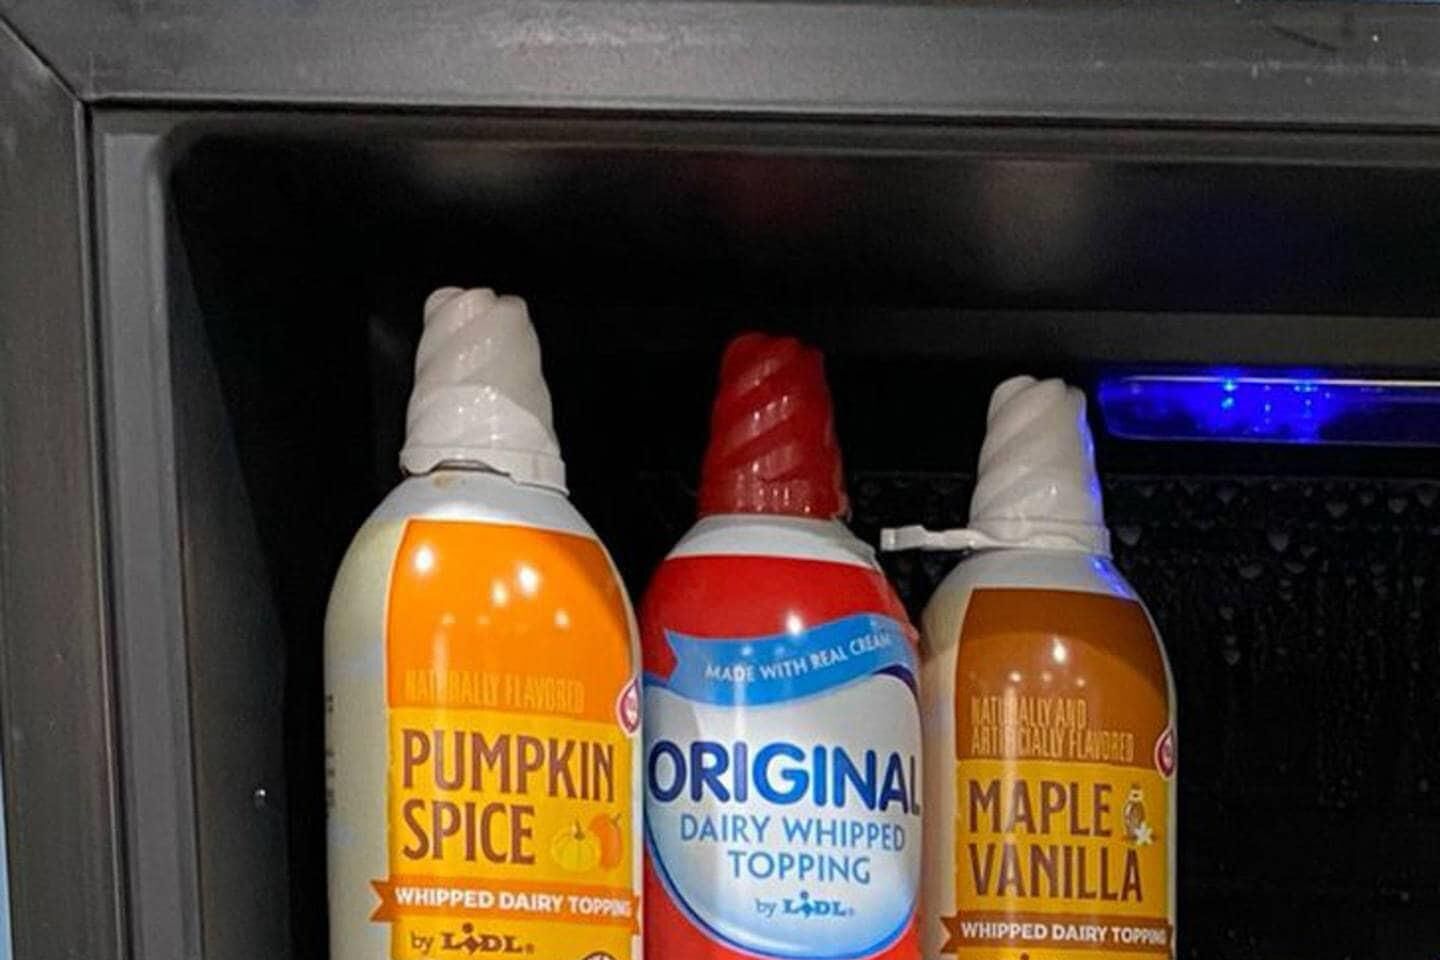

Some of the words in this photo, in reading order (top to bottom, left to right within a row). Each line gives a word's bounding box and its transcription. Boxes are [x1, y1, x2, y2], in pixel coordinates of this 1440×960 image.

[703, 662, 754, 683] MADE
[760, 660, 808, 681] WITH
[810, 645, 848, 670] REAL
[849, 631, 894, 656] CREAM
[1057, 699, 1087, 729] AND
[1069, 729, 1134, 763] FLAVORED
[402, 728, 615, 804] PUMPKIN
[649, 740, 920, 816] ORIGINAL
[968, 779, 1113, 838] MAPLE
[402, 798, 536, 865] SPICE
[681, 813, 771, 843] DAIRY
[782, 816, 906, 852] WHIPPED
[729, 850, 871, 886] TOPPING
[968, 842, 1143, 902] VANILLA
[395, 886, 495, 909] WHIPPED
[499, 890, 564, 912] DAIRY
[756, 897, 779, 922] by
[411, 931, 434, 955] by
[960, 921, 1048, 942] WHIPPED
[1050, 923, 1109, 943] DAIRY
